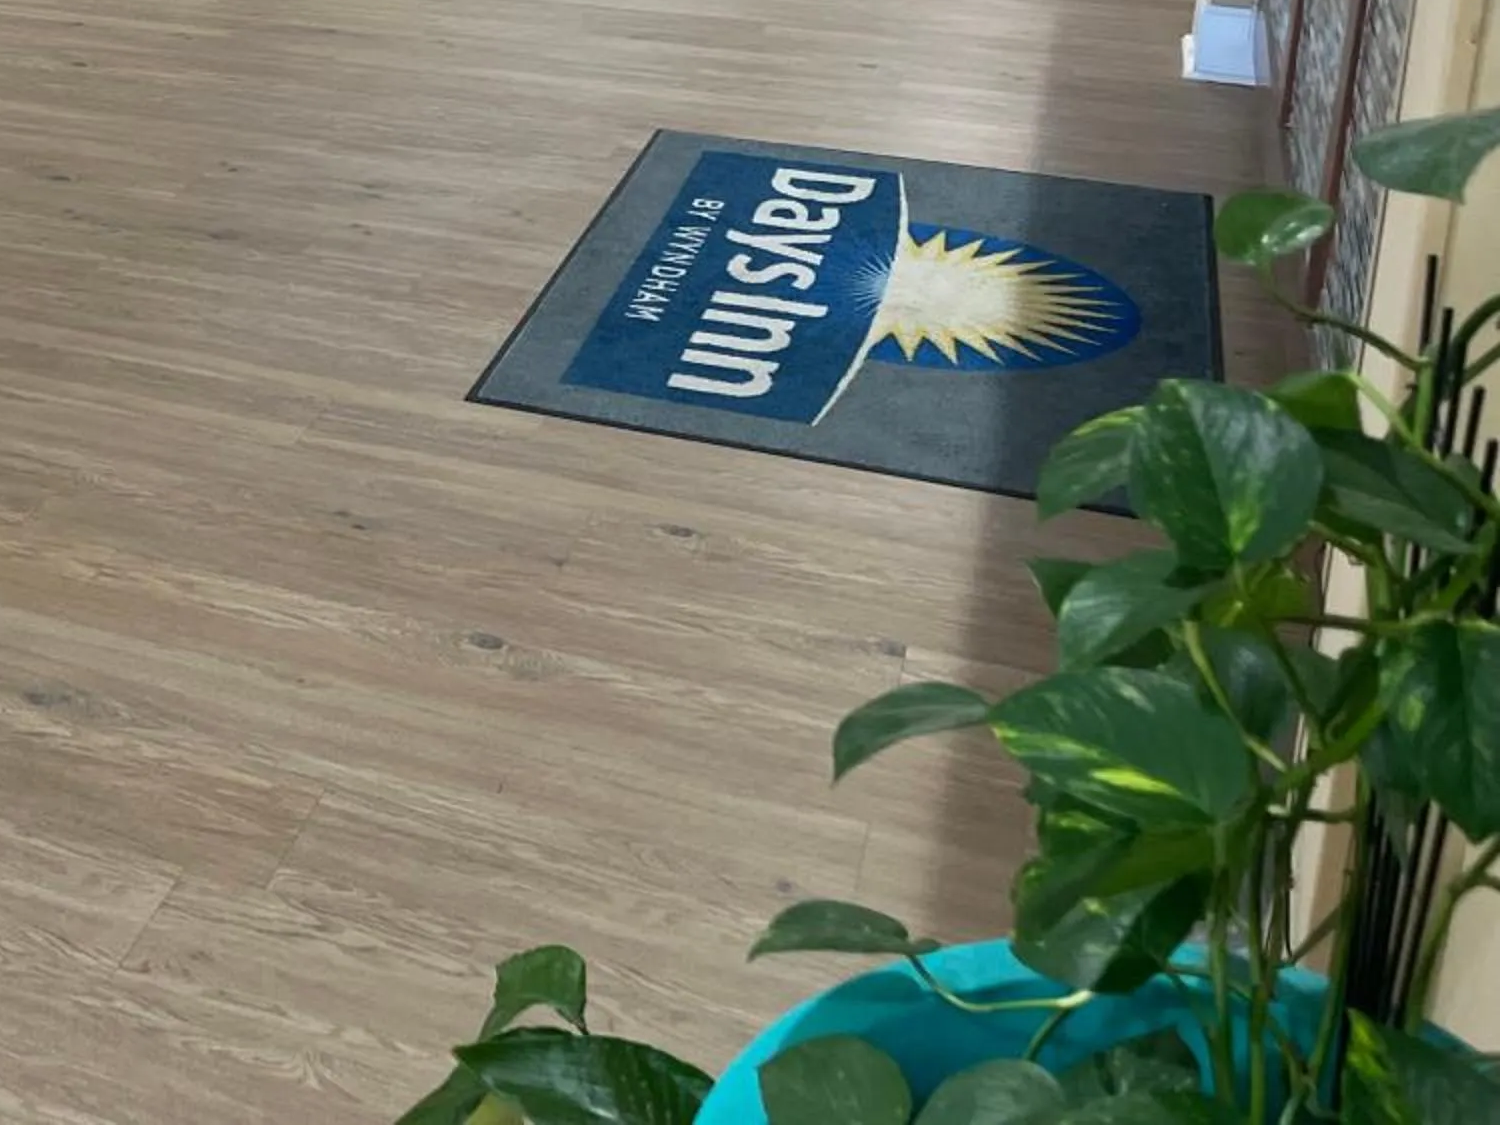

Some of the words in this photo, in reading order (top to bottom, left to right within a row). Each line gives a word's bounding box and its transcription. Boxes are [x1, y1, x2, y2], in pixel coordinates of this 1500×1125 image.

[687, 198, 725, 221] BY
[725, 168, 877, 290] Days
[624, 226, 712, 321] WYNDHAM
[666, 291, 829, 398] Inn
